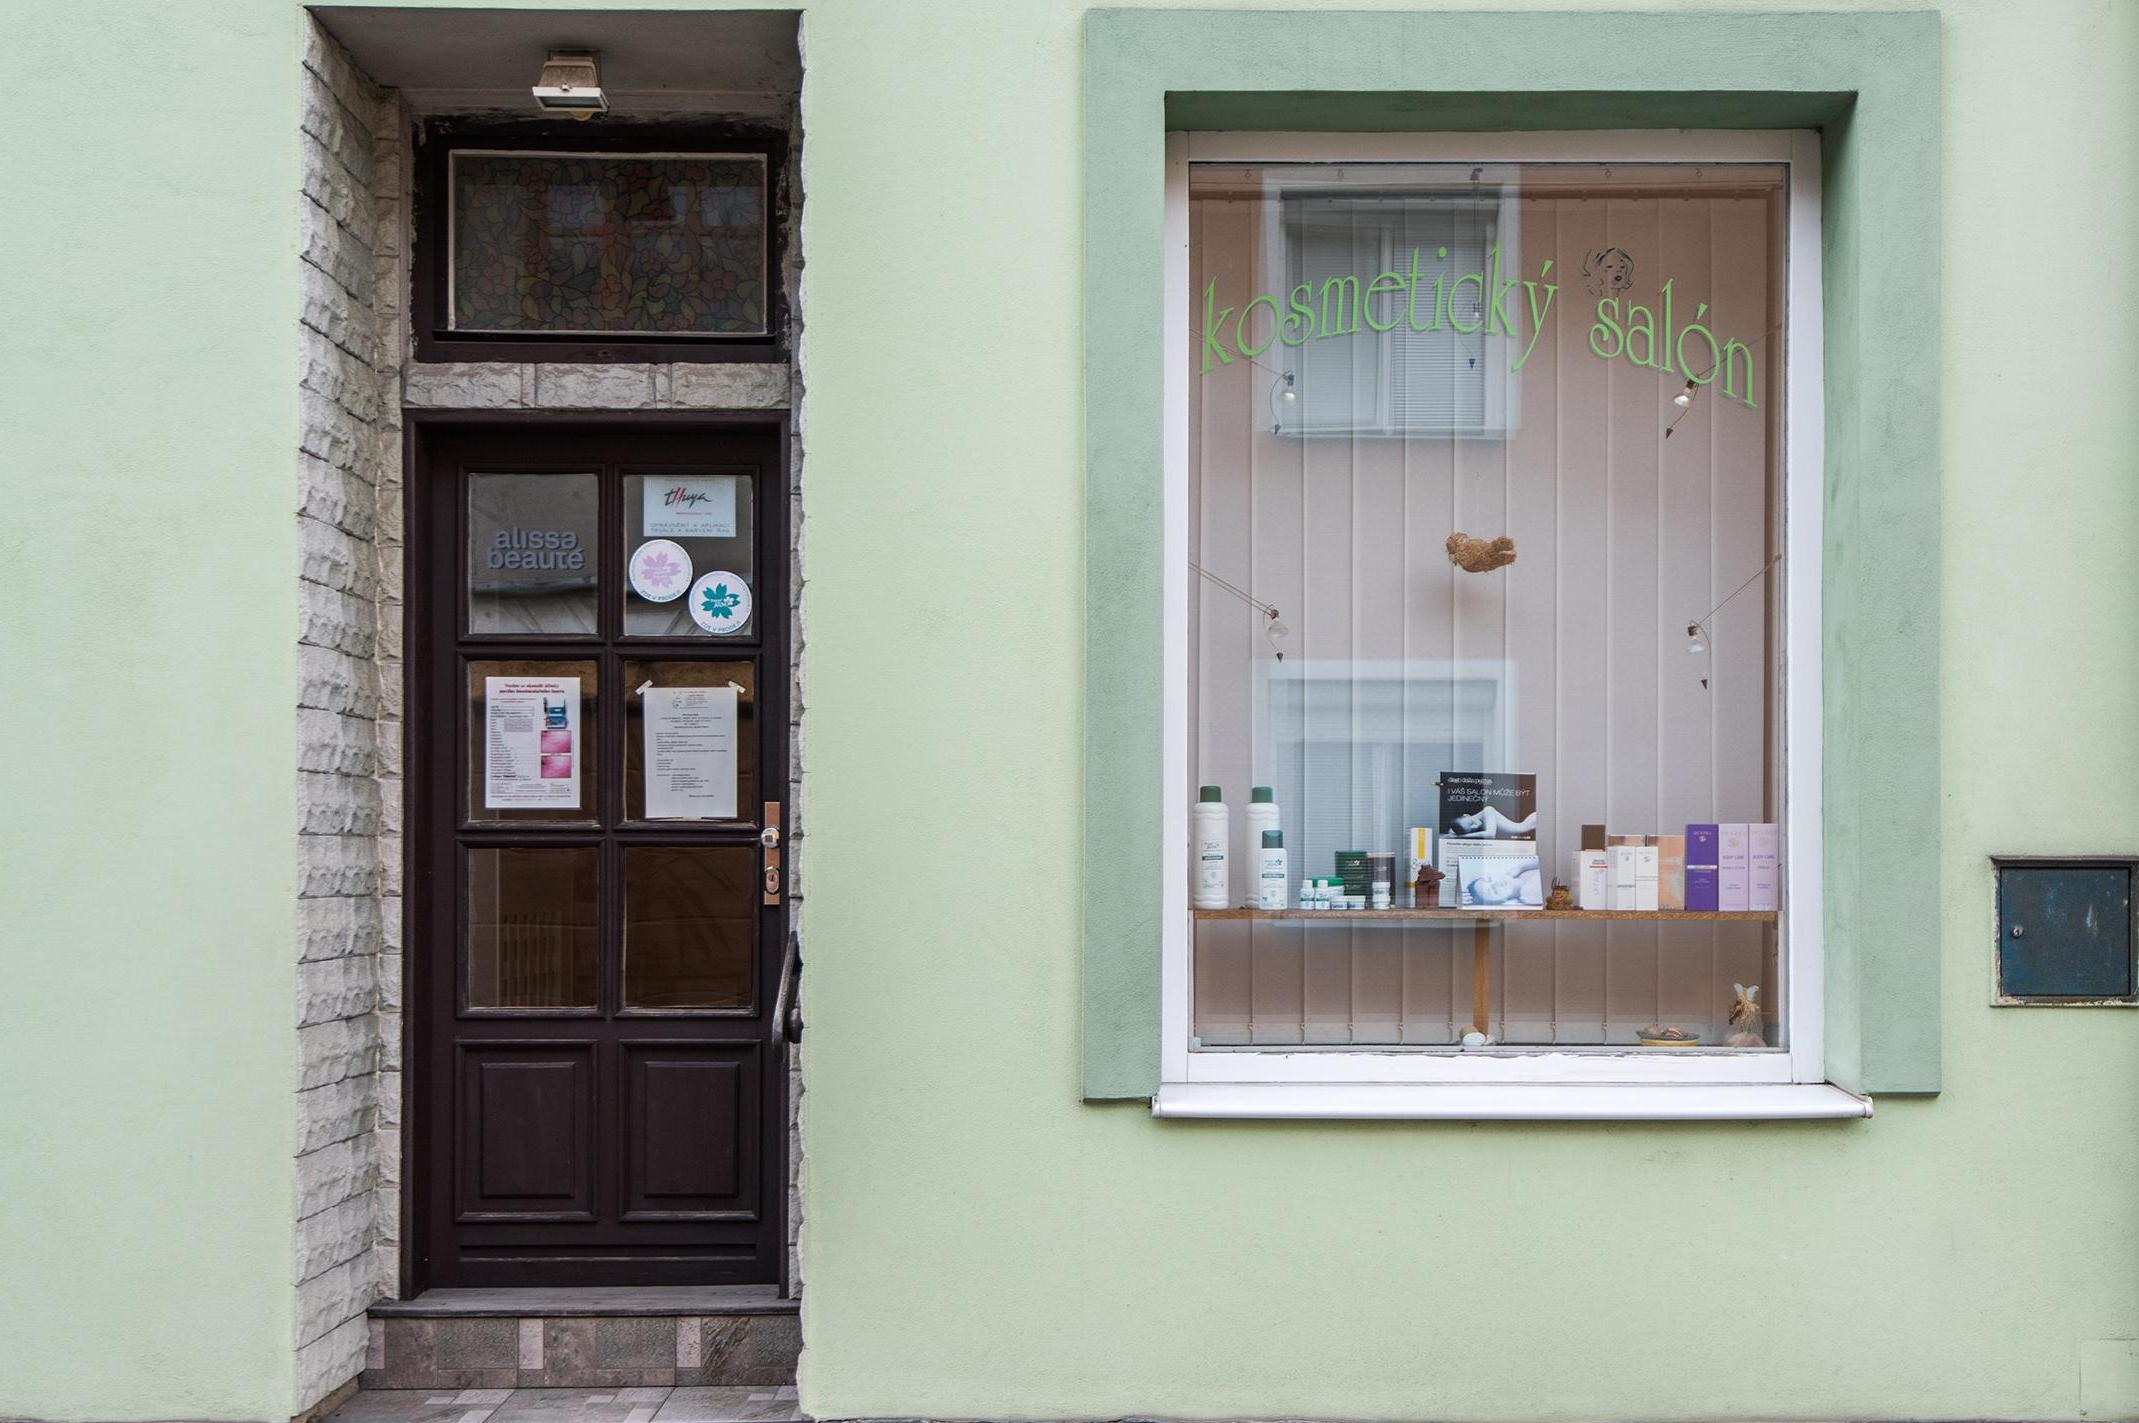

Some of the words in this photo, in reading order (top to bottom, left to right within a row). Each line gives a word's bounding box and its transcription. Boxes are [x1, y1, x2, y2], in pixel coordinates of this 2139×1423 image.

[1199, 243, 1558, 375] kosmetický
[1588, 278, 1758, 409] salón
[495, 527, 577, 549] alissa
[486, 547, 585, 569] beauté
